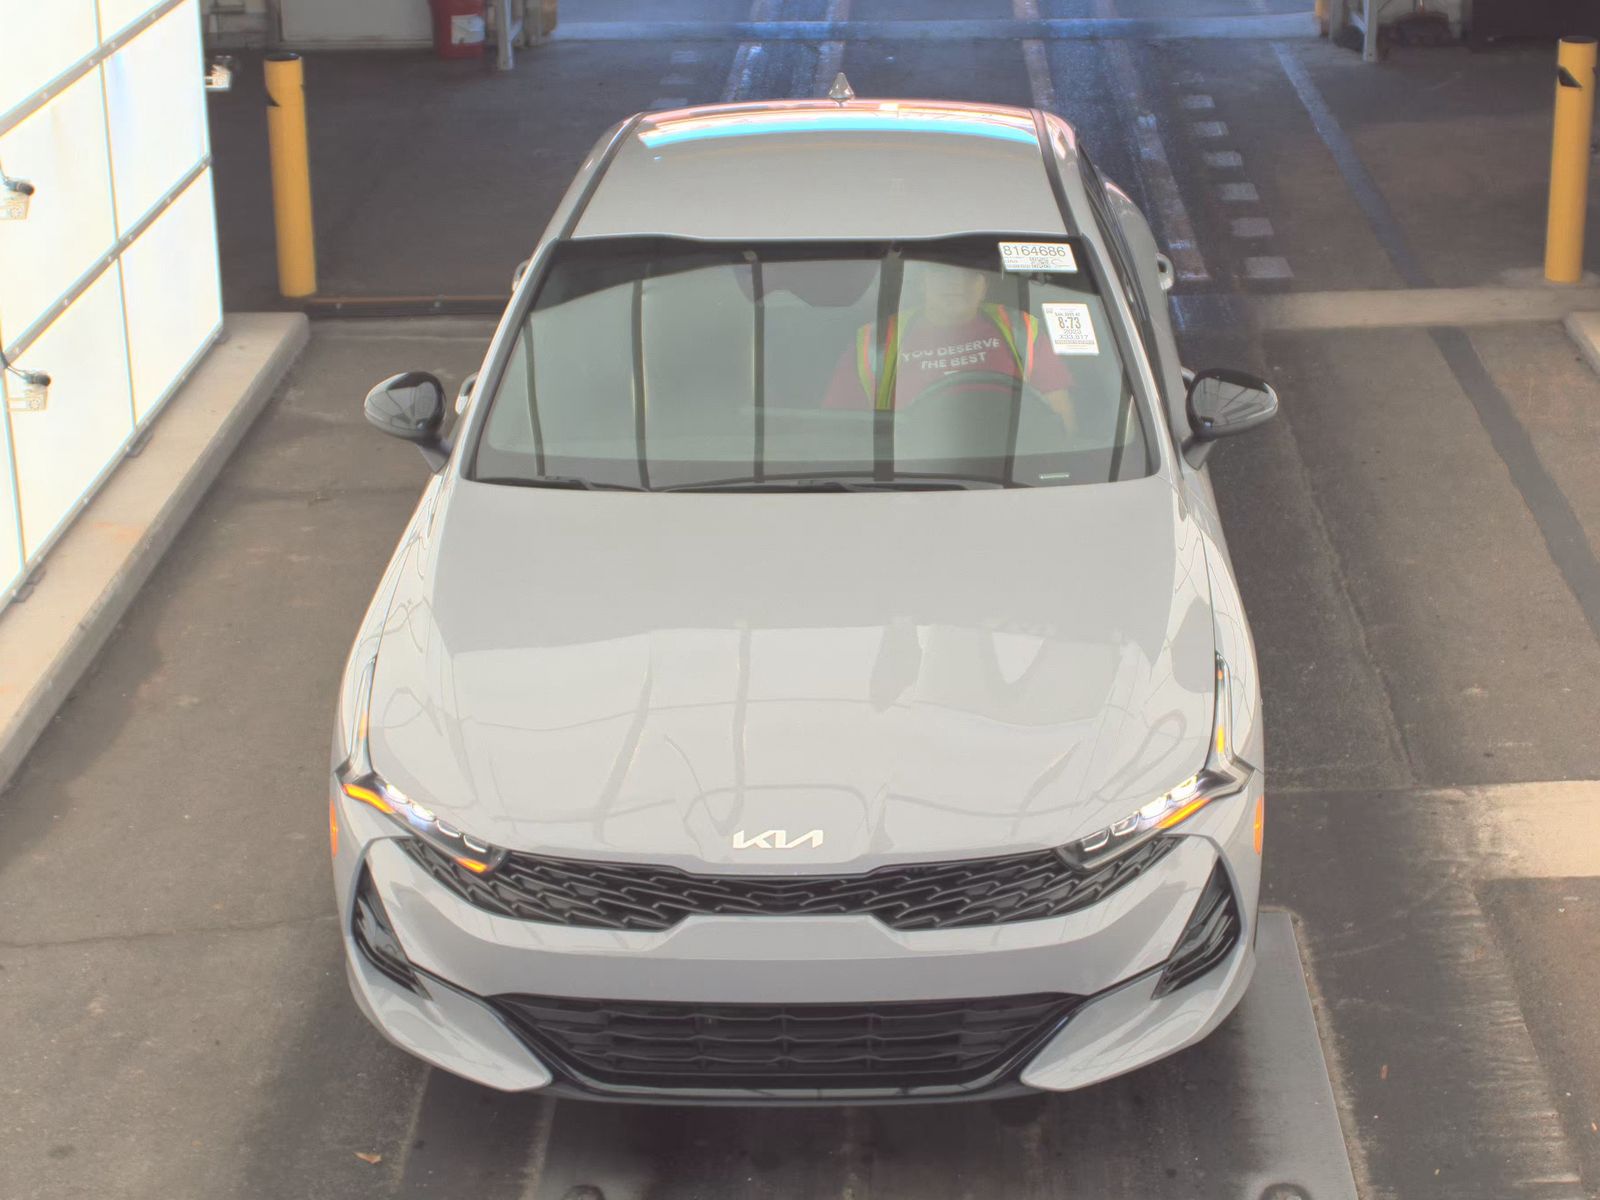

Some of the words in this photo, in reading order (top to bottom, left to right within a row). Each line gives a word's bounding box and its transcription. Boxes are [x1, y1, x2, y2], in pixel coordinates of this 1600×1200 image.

[1003, 245, 1066, 257] 8164686
[902, 349, 934, 361] YOU
[937, 338, 1000, 355] DESERVE
[921, 359, 948, 369] THE
[950, 351, 987, 367] BEST
[733, 829, 824, 849] KIA
